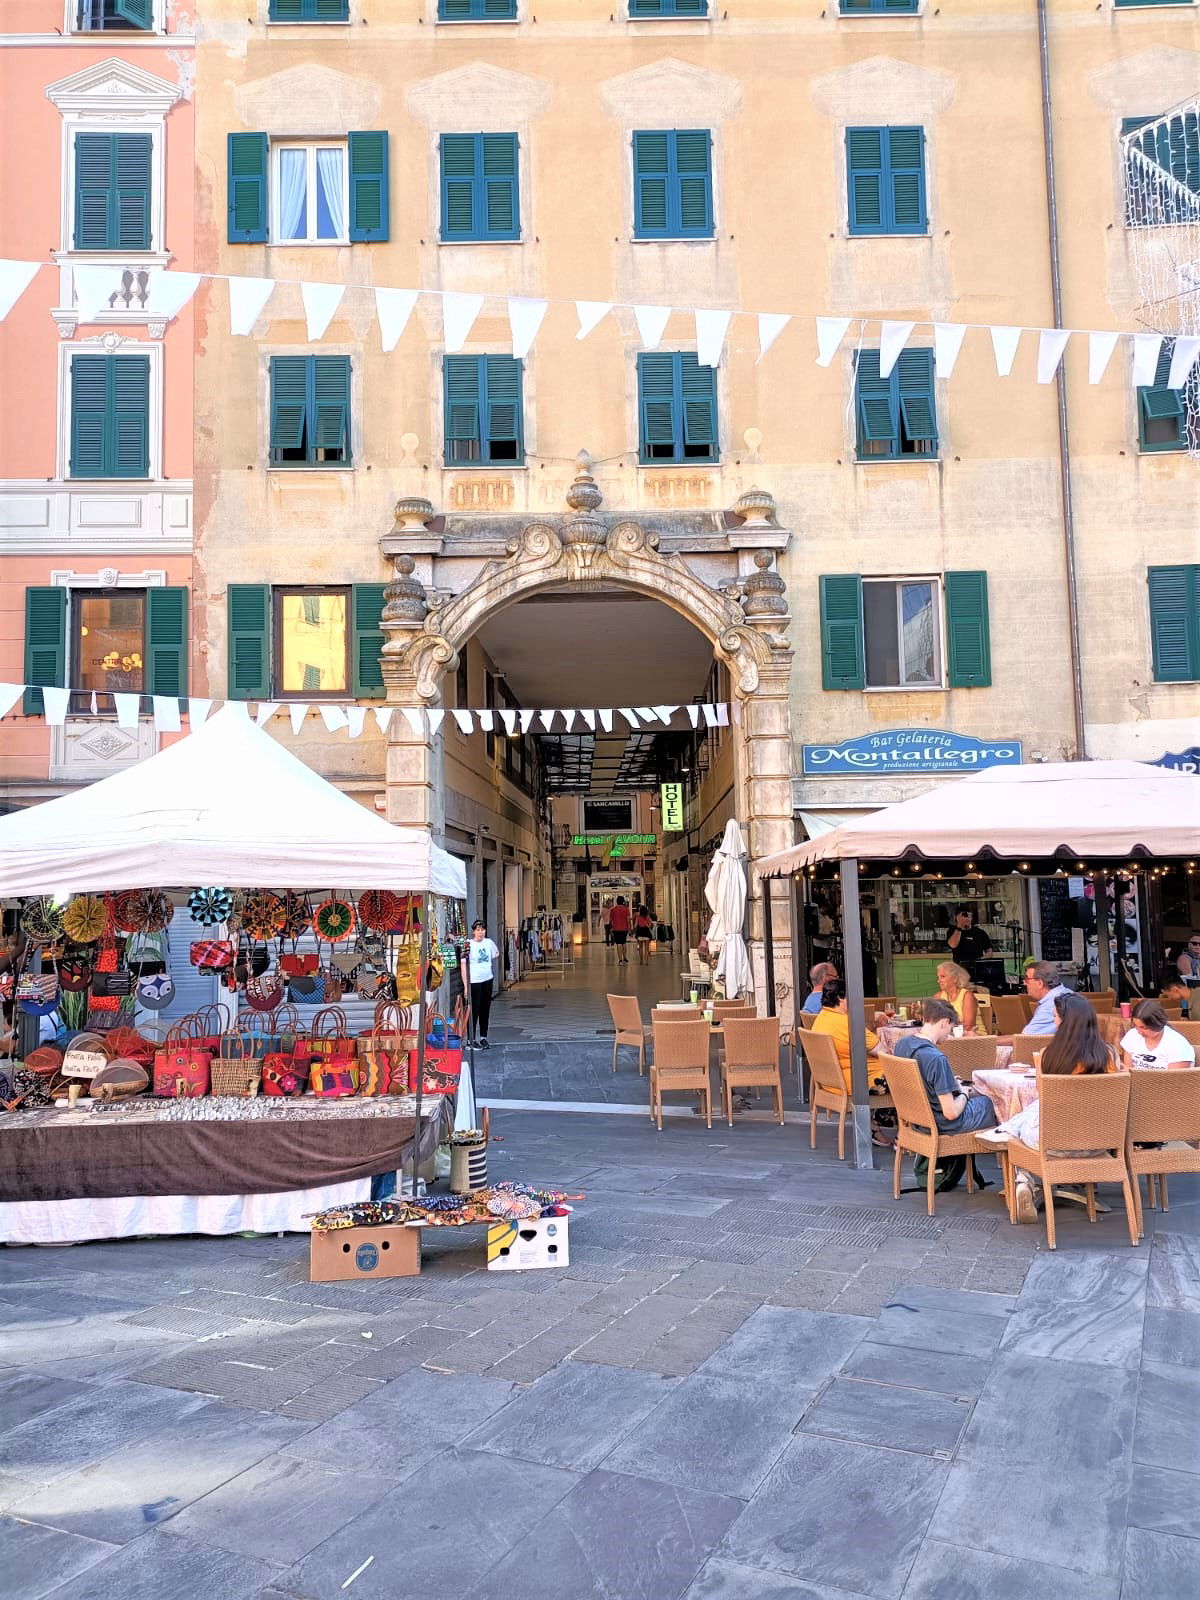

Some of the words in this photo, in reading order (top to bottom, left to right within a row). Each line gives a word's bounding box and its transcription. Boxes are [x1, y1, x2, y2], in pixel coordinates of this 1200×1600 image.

[870, 737, 893, 748] Bar
[896, 732, 952, 747] Gelateria
[811, 747, 1014, 766] Montallegro
[883, 762, 919, 771] produzione
[921, 760, 959, 769] artigianale
[665, 784, 678, 825] HOTEL
